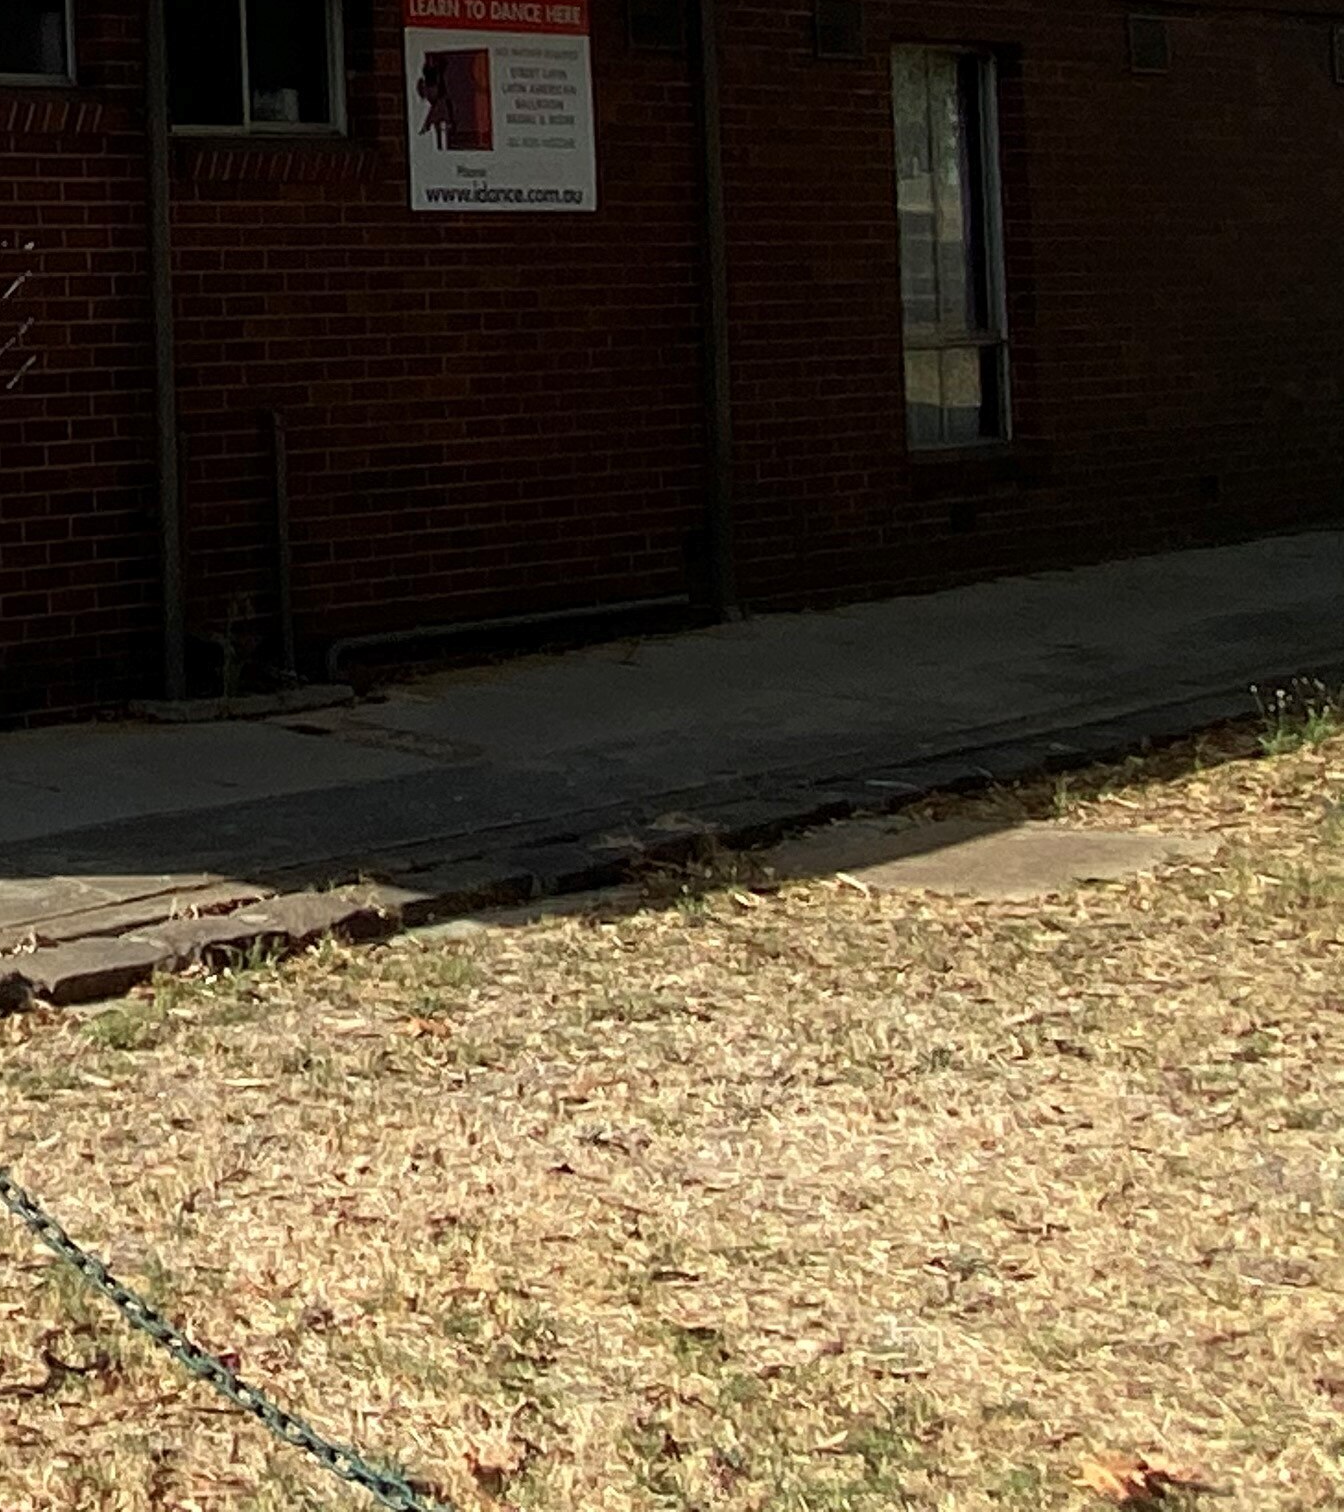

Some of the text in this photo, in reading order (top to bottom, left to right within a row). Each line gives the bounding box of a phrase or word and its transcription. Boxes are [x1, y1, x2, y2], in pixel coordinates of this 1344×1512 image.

[465, 0, 487, 19] TO
[490, 1, 542, 24] DANCE
[546, 3, 581, 25] HERE
[425, 180, 584, 205] www.idance.com.au
